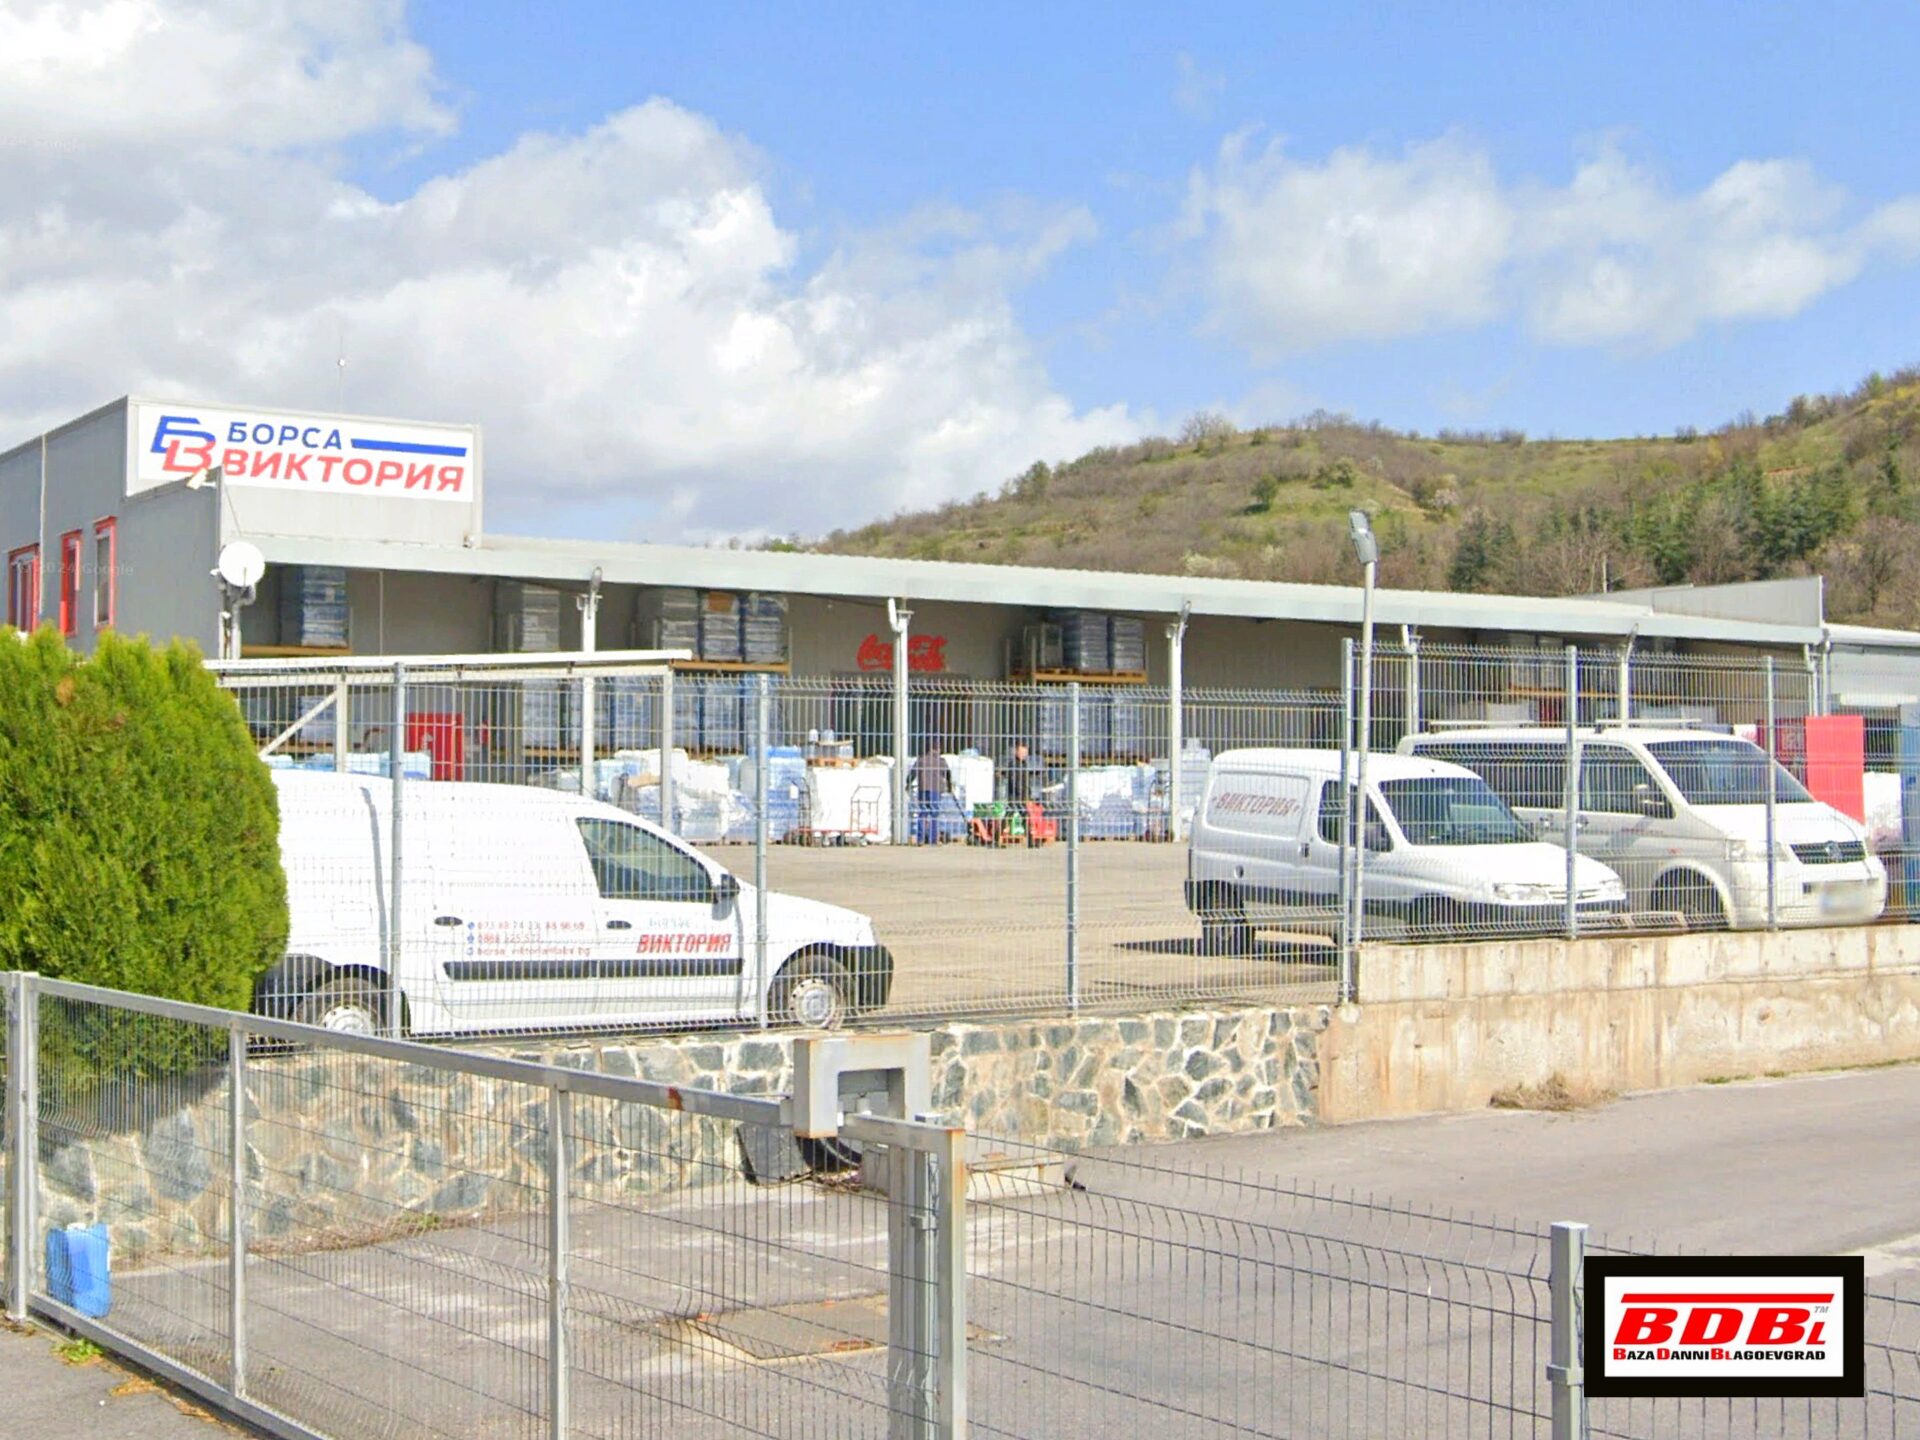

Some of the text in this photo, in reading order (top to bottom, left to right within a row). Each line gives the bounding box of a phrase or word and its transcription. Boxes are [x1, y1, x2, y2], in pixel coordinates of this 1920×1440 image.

[227, 422, 342, 450] БОРСА
[222, 448, 464, 492] ВИКТОРИЯ
[636, 932, 732, 954] ВИКТОРИЯ
